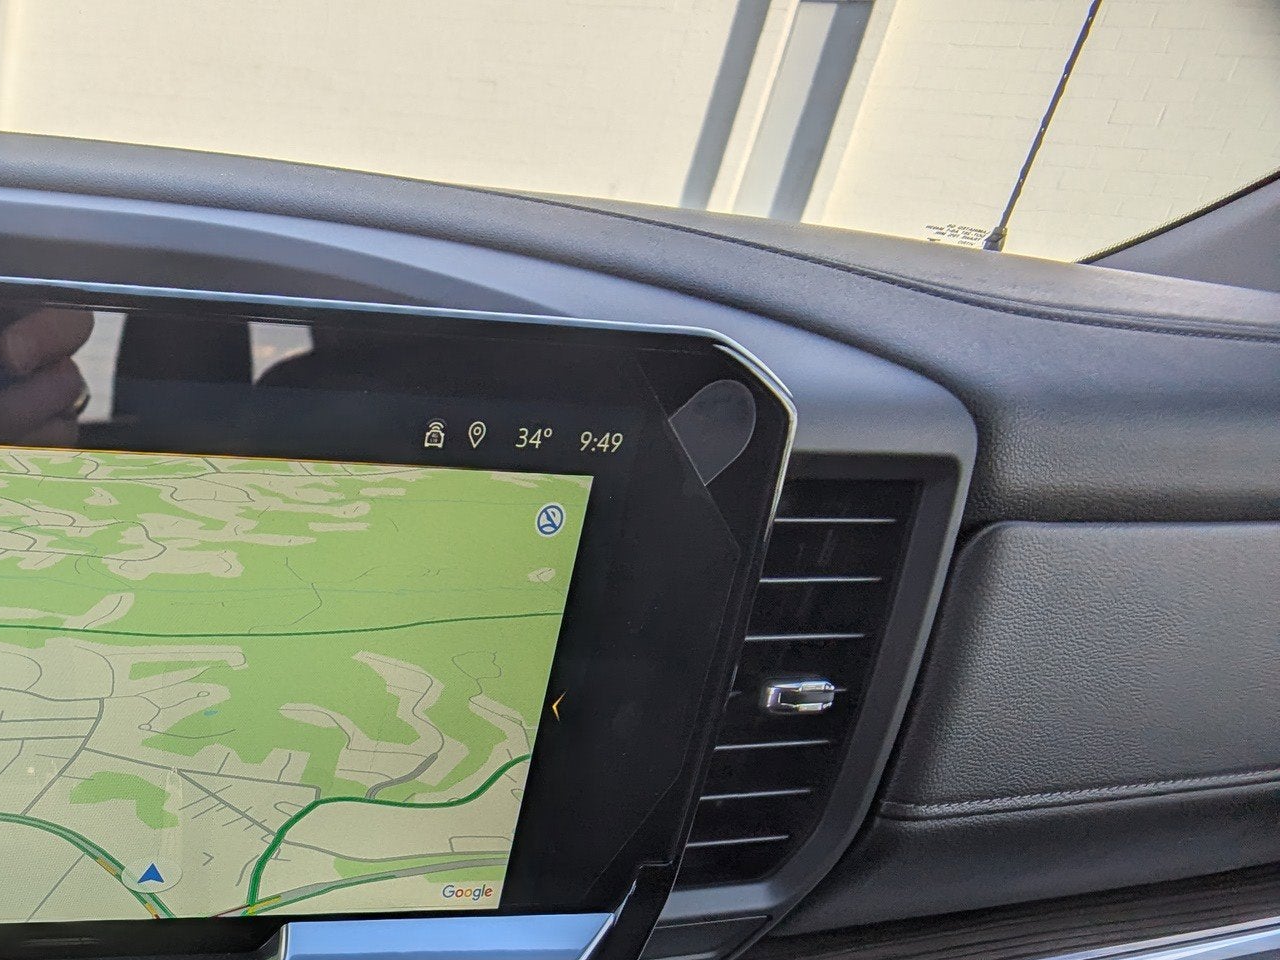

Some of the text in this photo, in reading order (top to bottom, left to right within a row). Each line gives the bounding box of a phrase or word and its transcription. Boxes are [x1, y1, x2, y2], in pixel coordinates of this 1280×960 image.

[516, 427, 624, 453] 34° 9:49
[442, 884, 493, 900] Google
